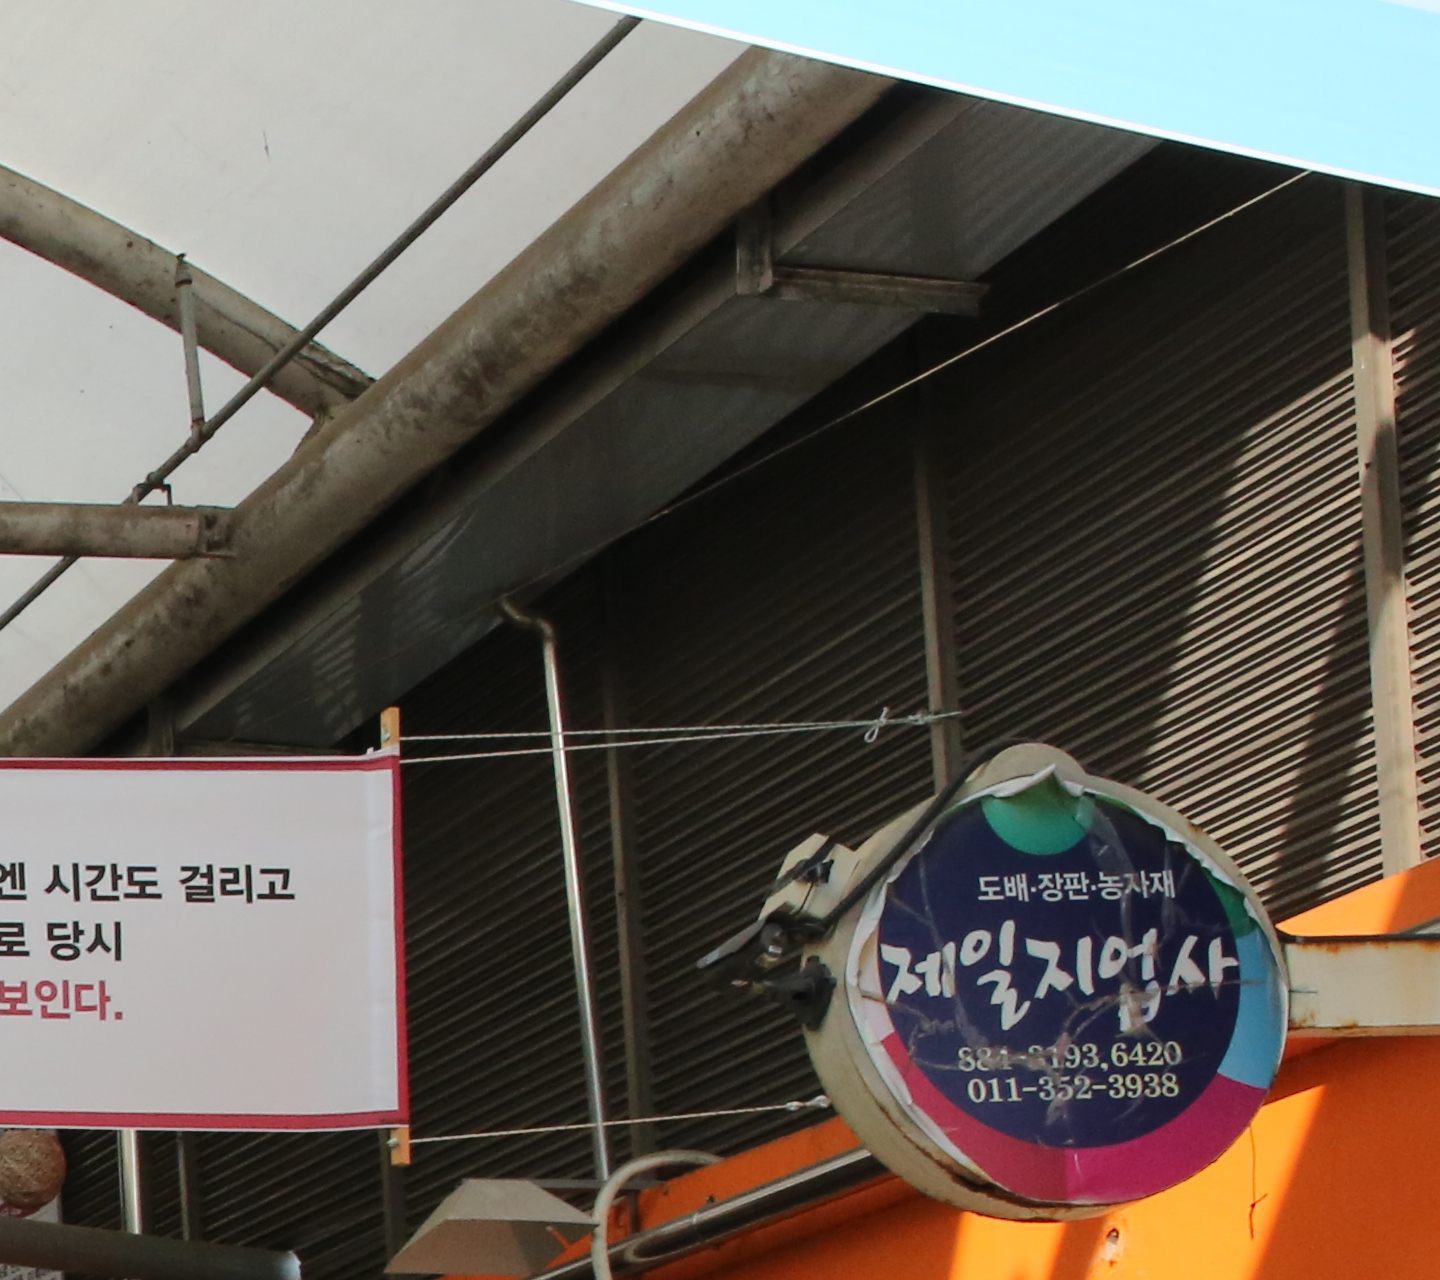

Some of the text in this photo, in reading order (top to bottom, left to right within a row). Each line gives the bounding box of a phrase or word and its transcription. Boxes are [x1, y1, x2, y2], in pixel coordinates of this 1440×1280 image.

[46, 862, 161, 903] 시간도
[178, 862, 295, 905] 걸리고
[978, 870, 1176, 902] 도배·장판·농자재
[47, 918, 123, 962] 당시
[881, 919, 1239, 1032] 제일지업사
[967, 1073, 1179, 1103] 011-352-3938
